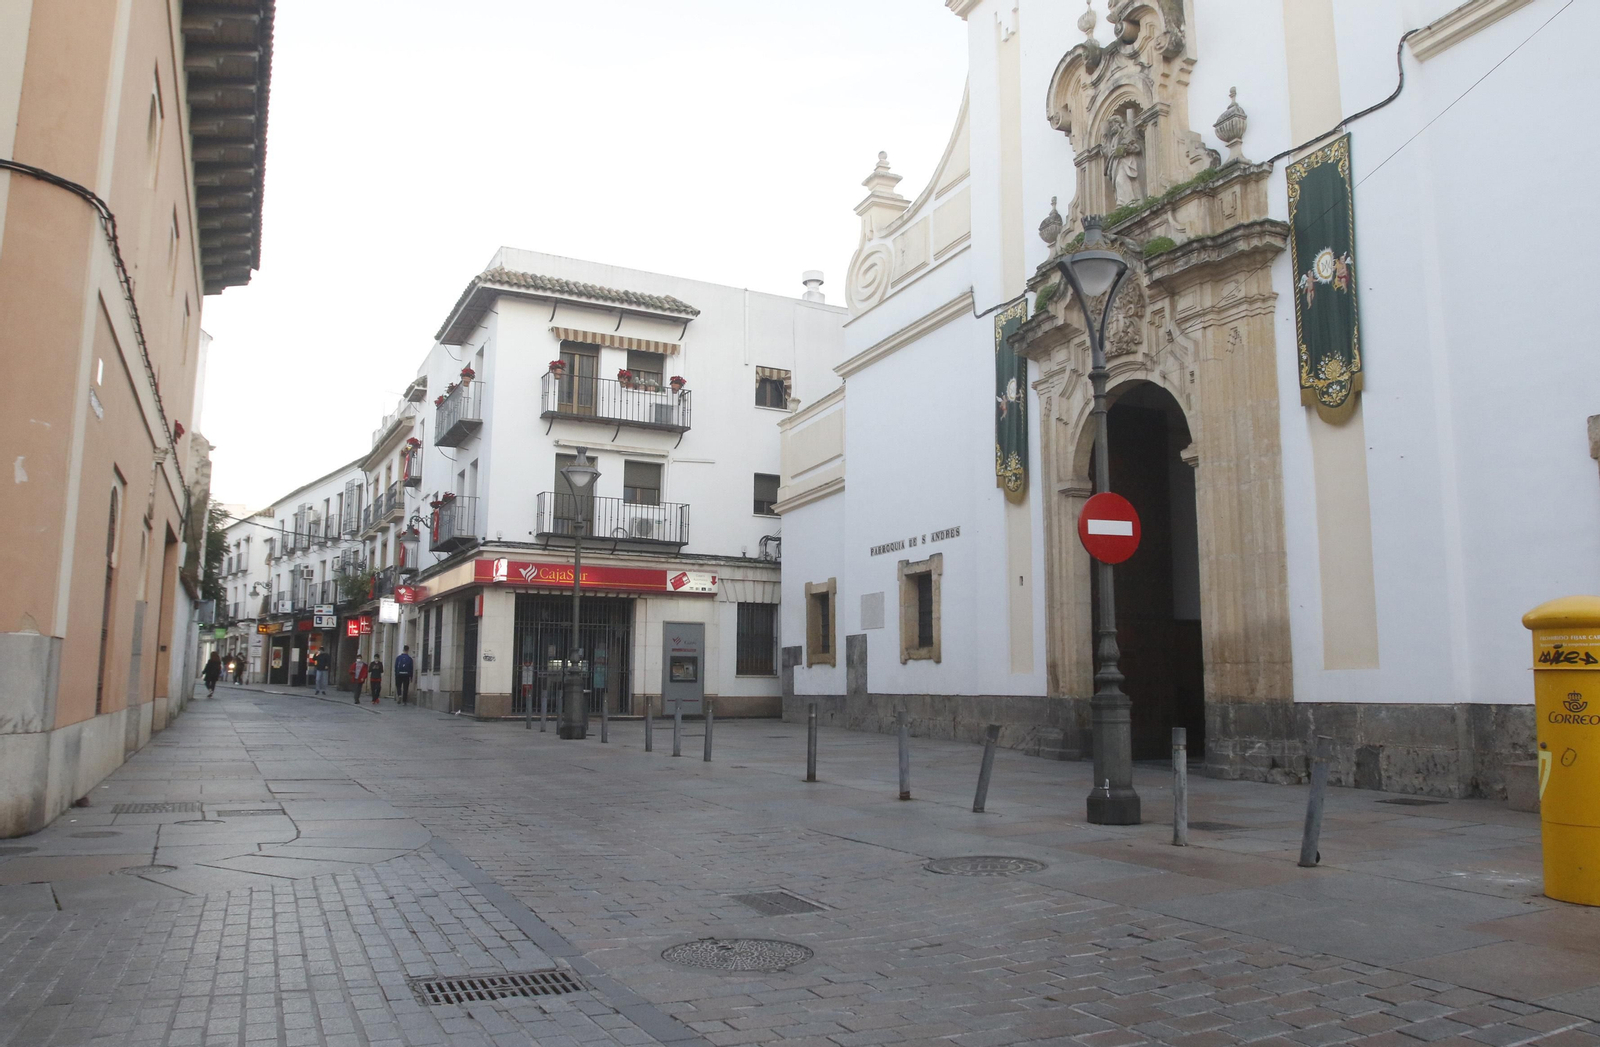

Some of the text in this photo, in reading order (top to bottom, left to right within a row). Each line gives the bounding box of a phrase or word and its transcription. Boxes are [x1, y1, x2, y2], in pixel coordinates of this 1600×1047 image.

[870, 526, 961, 557] PARROQUIA DE S ANDRES
